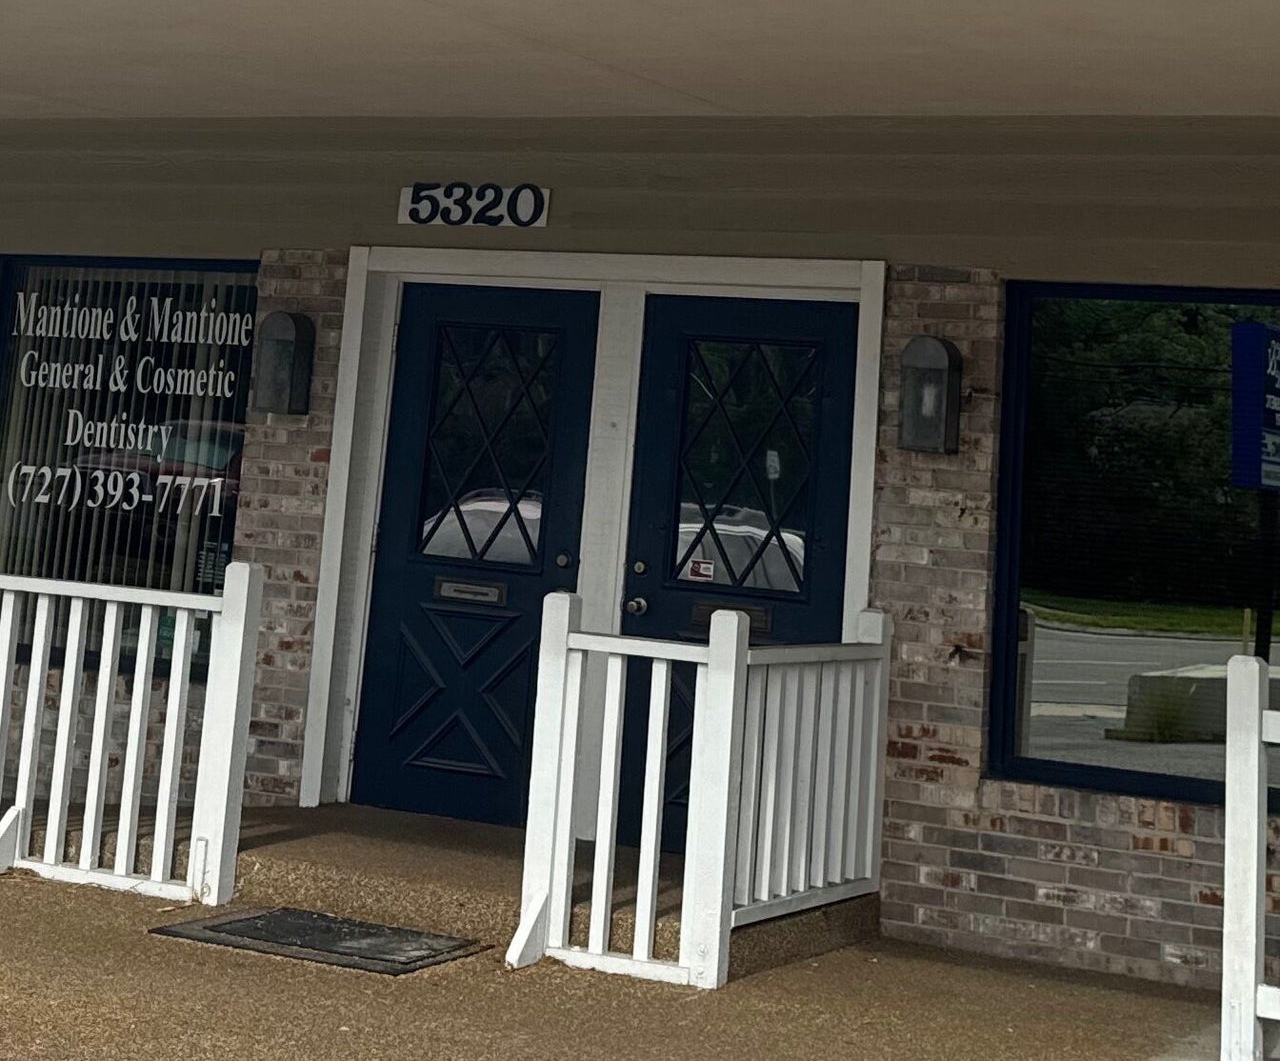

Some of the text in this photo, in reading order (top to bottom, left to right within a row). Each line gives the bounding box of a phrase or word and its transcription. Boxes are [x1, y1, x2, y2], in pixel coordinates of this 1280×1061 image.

[409, 182, 545, 227] 5320
[12, 292, 252, 347] Mantione & Mantione
[20, 350, 235, 398] General & Cosmetic
[64, 409, 173, 463] Dentistry
[7, 461, 225, 517] (727) 393-7771
